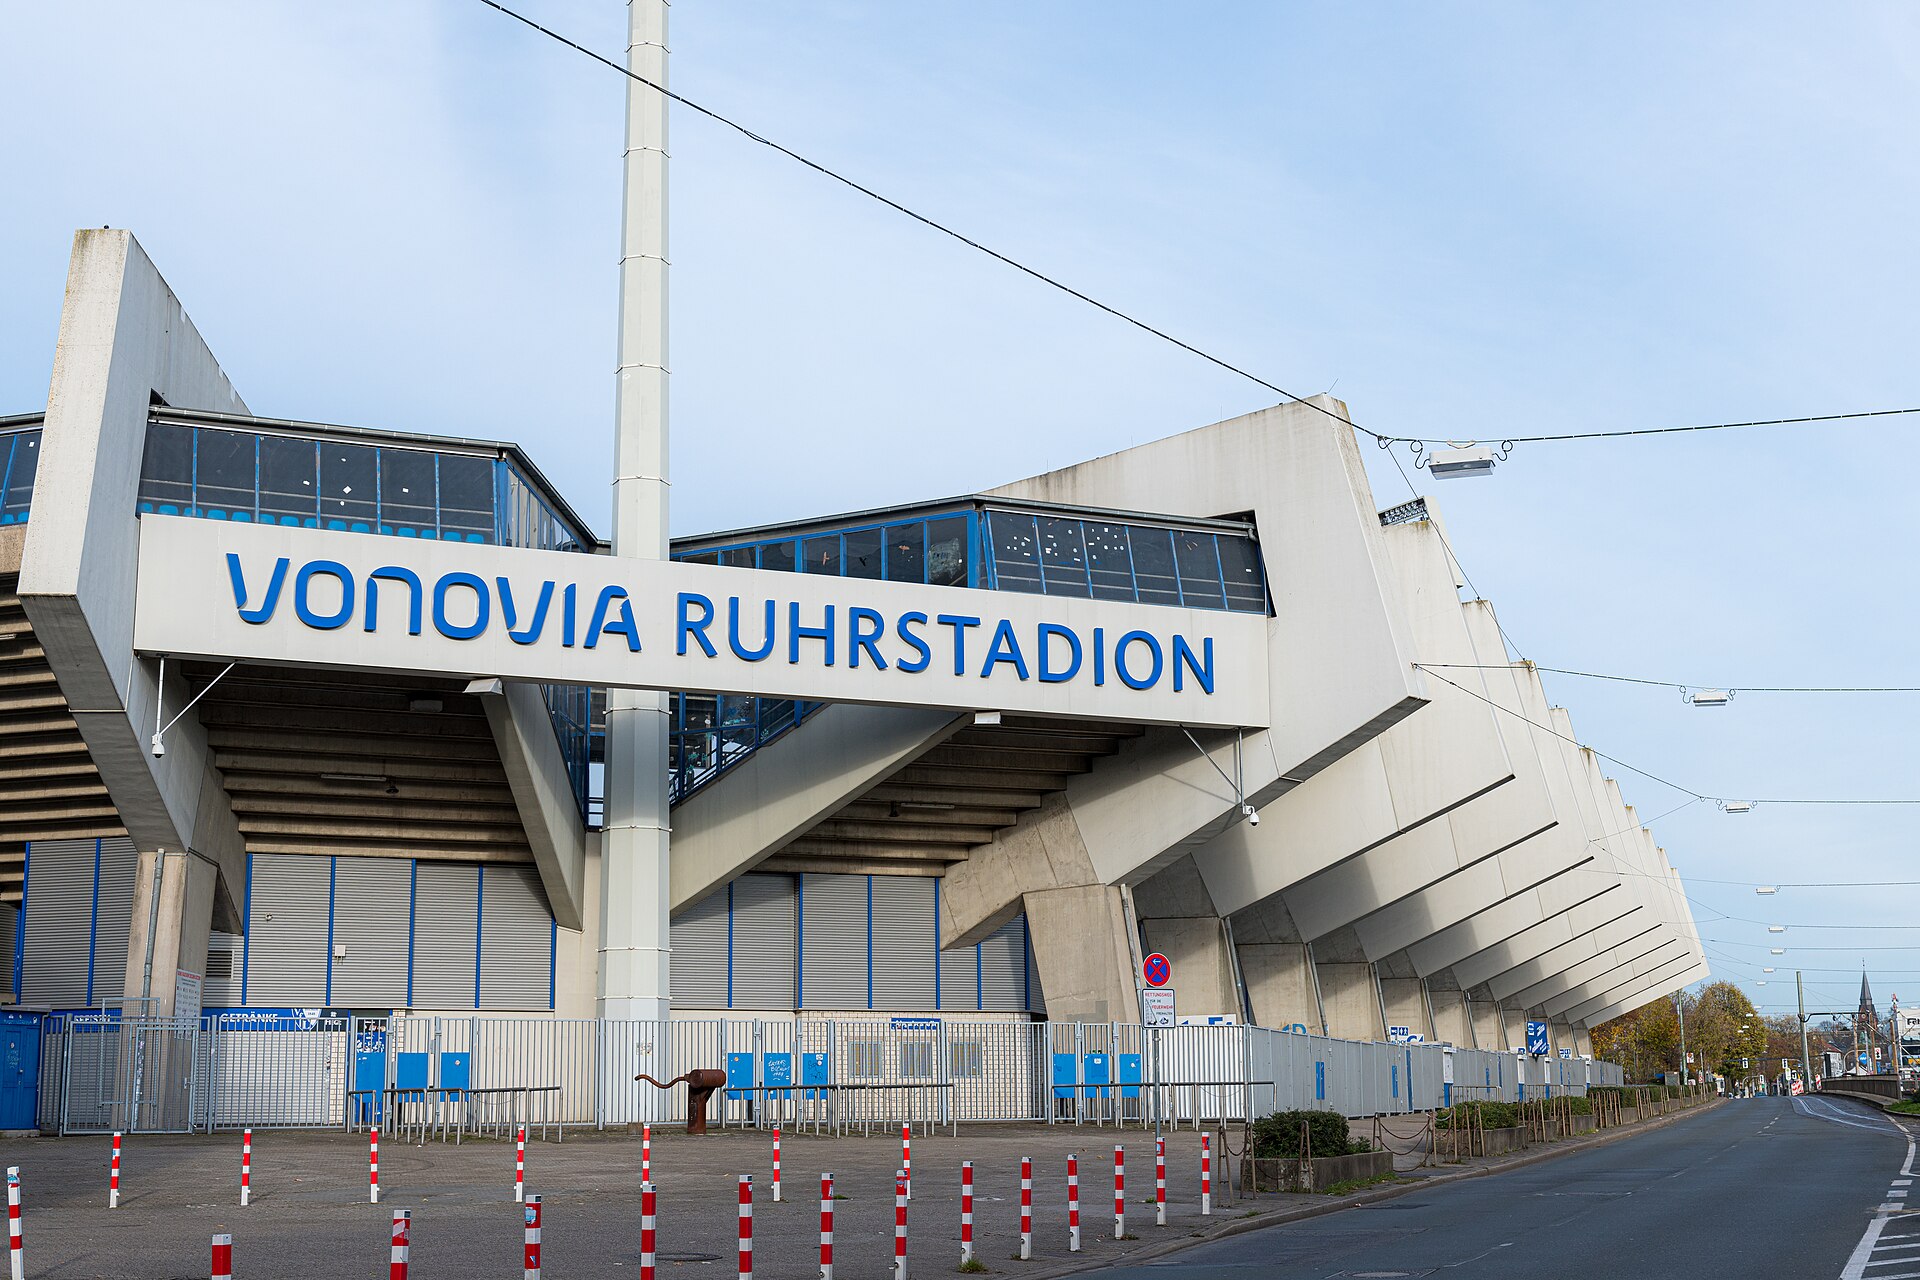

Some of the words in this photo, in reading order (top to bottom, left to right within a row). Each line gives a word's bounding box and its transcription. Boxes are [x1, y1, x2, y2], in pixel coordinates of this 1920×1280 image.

[226, 553, 642, 652] VONOVIA
[676, 591, 1215, 695] RUHRSTADION
[220, 1012, 279, 1023] GETRÄNKE
